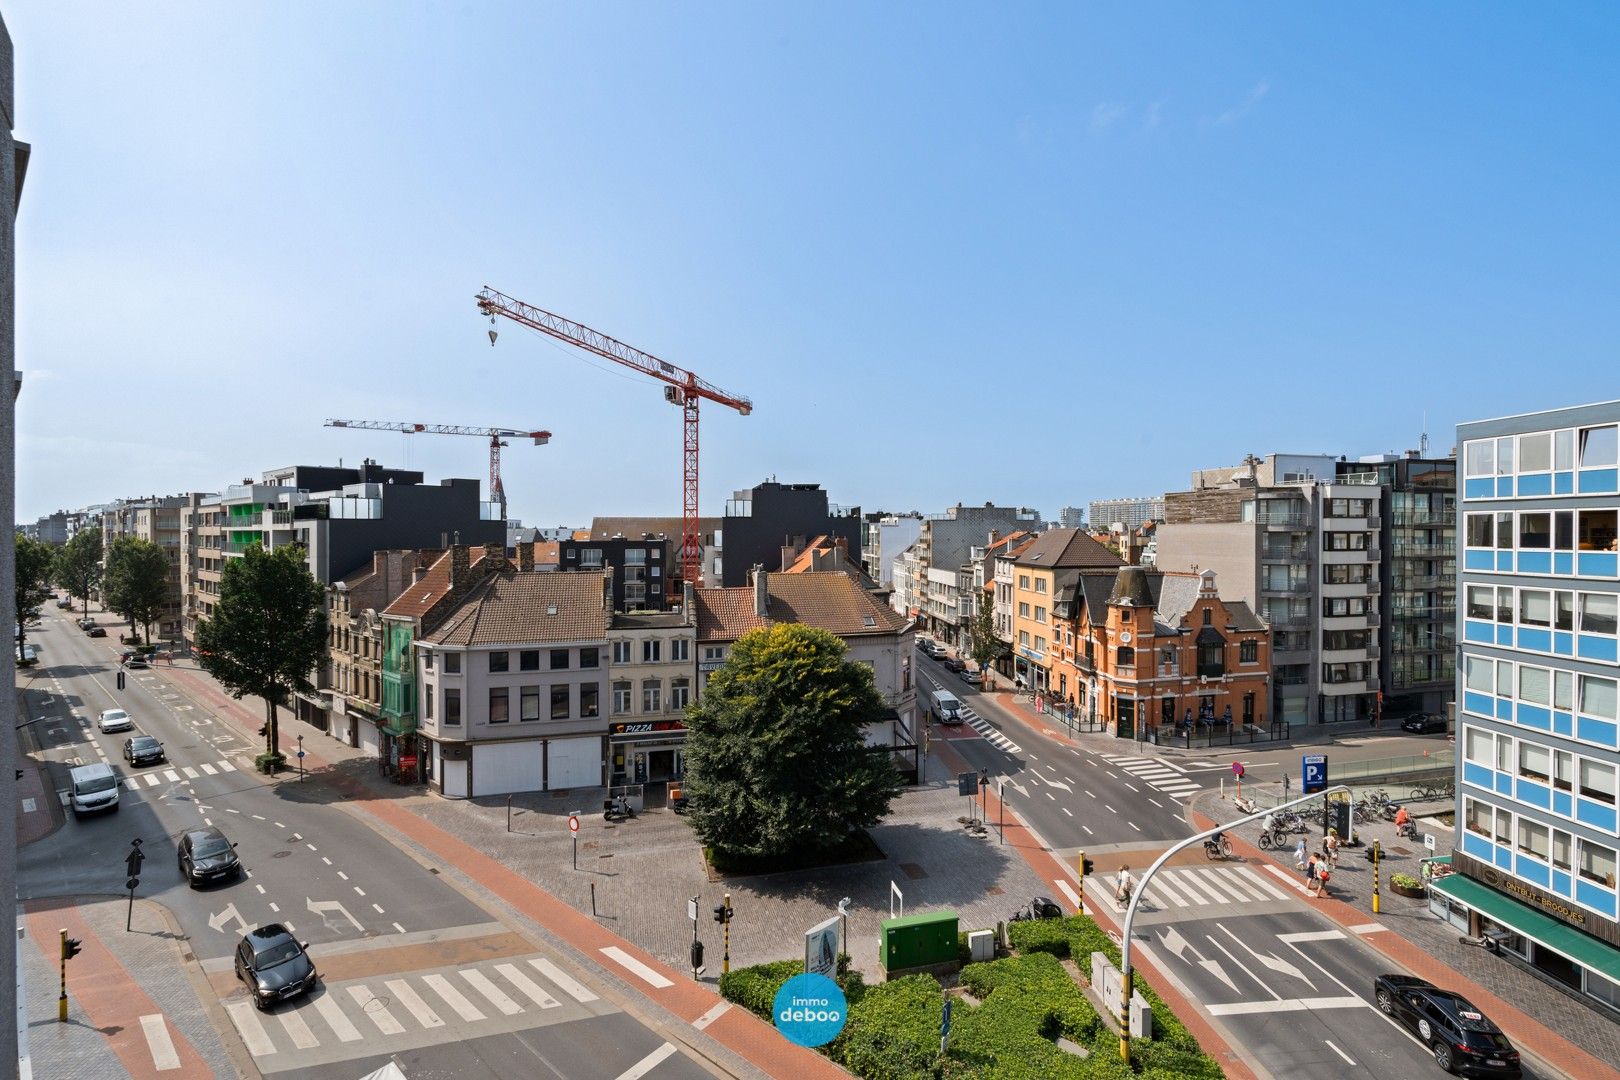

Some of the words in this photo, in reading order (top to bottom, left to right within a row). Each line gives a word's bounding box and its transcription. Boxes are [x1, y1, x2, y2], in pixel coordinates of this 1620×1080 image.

[625, 723, 652, 733] PIZZA
[1306, 765, 1318, 781] P
[1505, 880, 1537, 902] ONTBIJT
[1541, 897, 1585, 923] BROODJES
